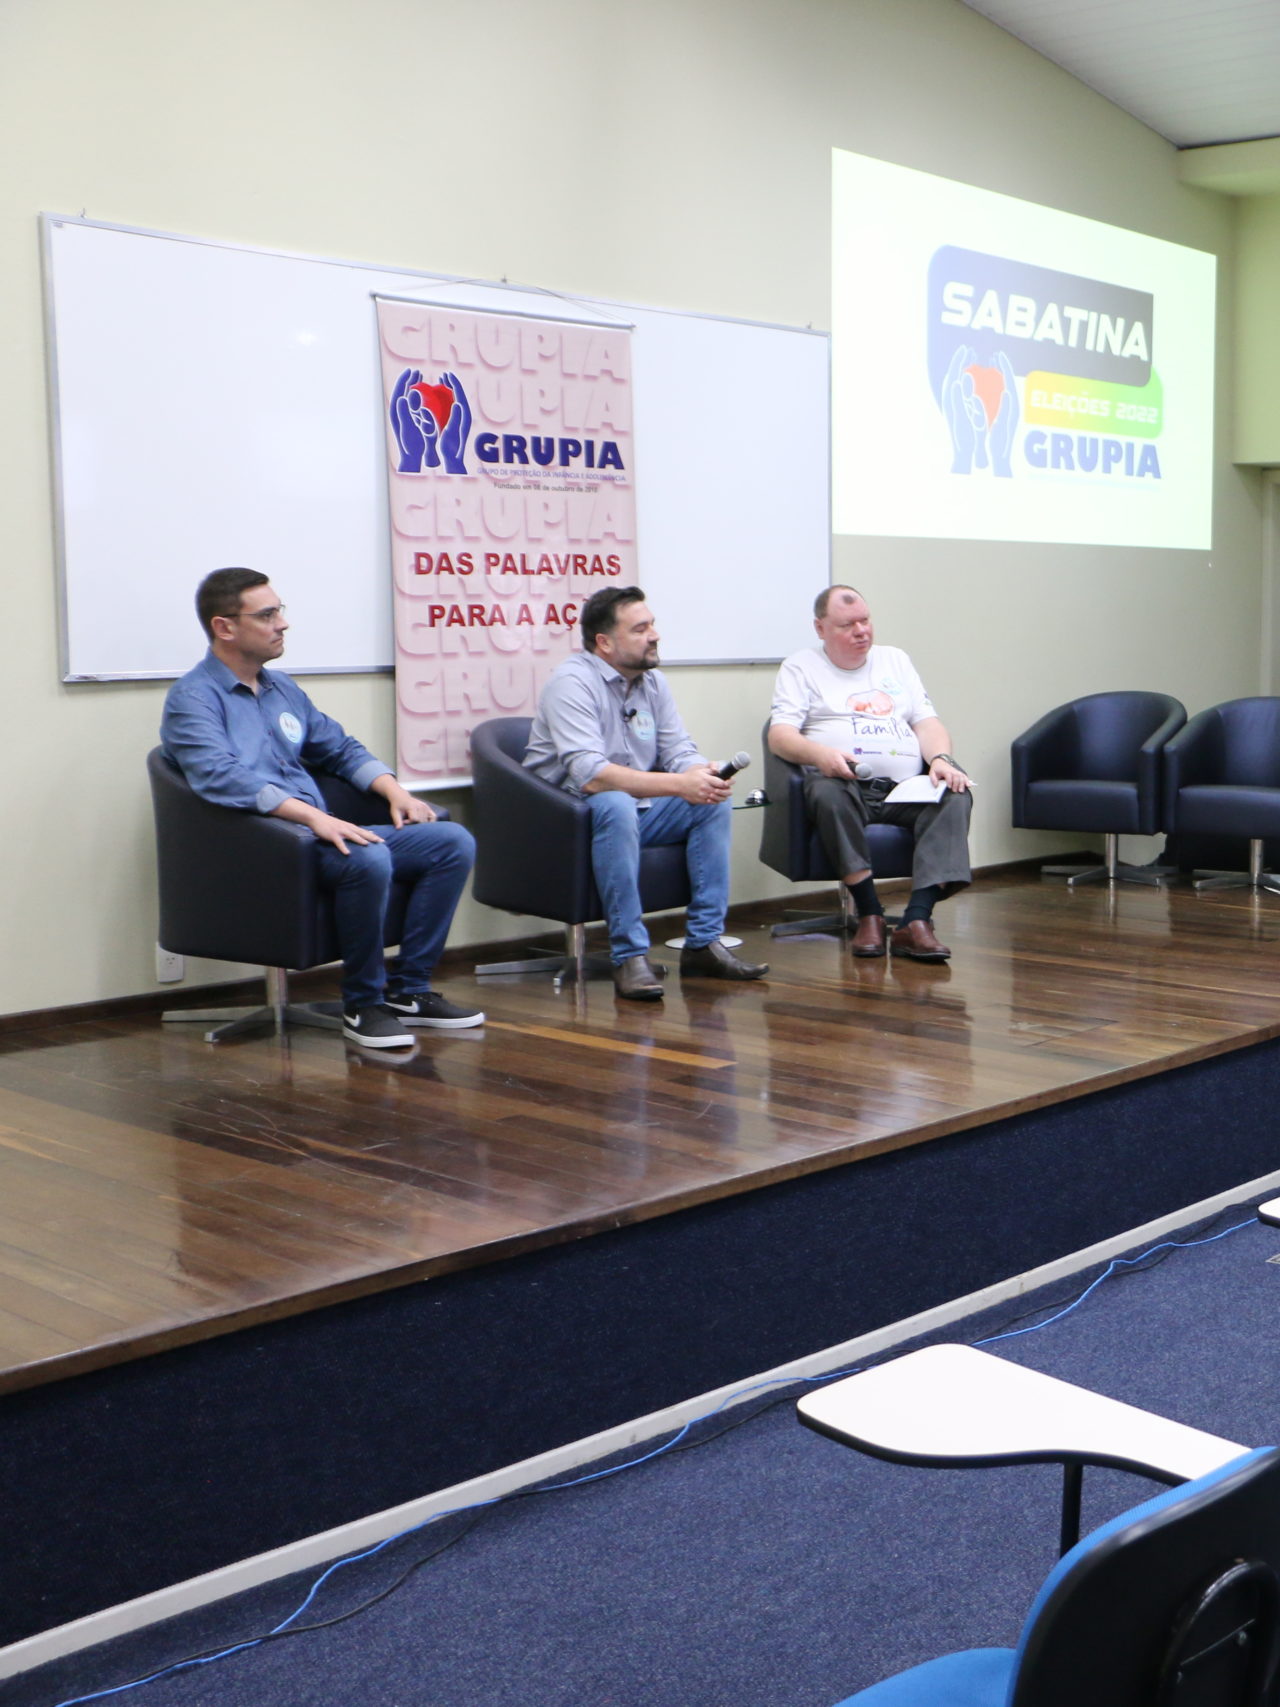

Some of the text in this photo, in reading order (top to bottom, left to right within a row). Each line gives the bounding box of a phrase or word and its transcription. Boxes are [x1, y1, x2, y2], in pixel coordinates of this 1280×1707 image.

[940, 281, 1149, 362] SABATINA
[1031, 388, 1159, 424] ELEIÇÕES 2022
[474, 432, 625, 470] GRUPIA
[1023, 430, 1162, 480] GRUPIA
[477, 467, 499, 476] GRUPO
[500, 468, 508, 476] DE
[493, 482, 521, 490] Fundado
[414, 551, 622, 577] DAS PALAVRAS
[427, 600, 584, 631] PARA A AÇ
